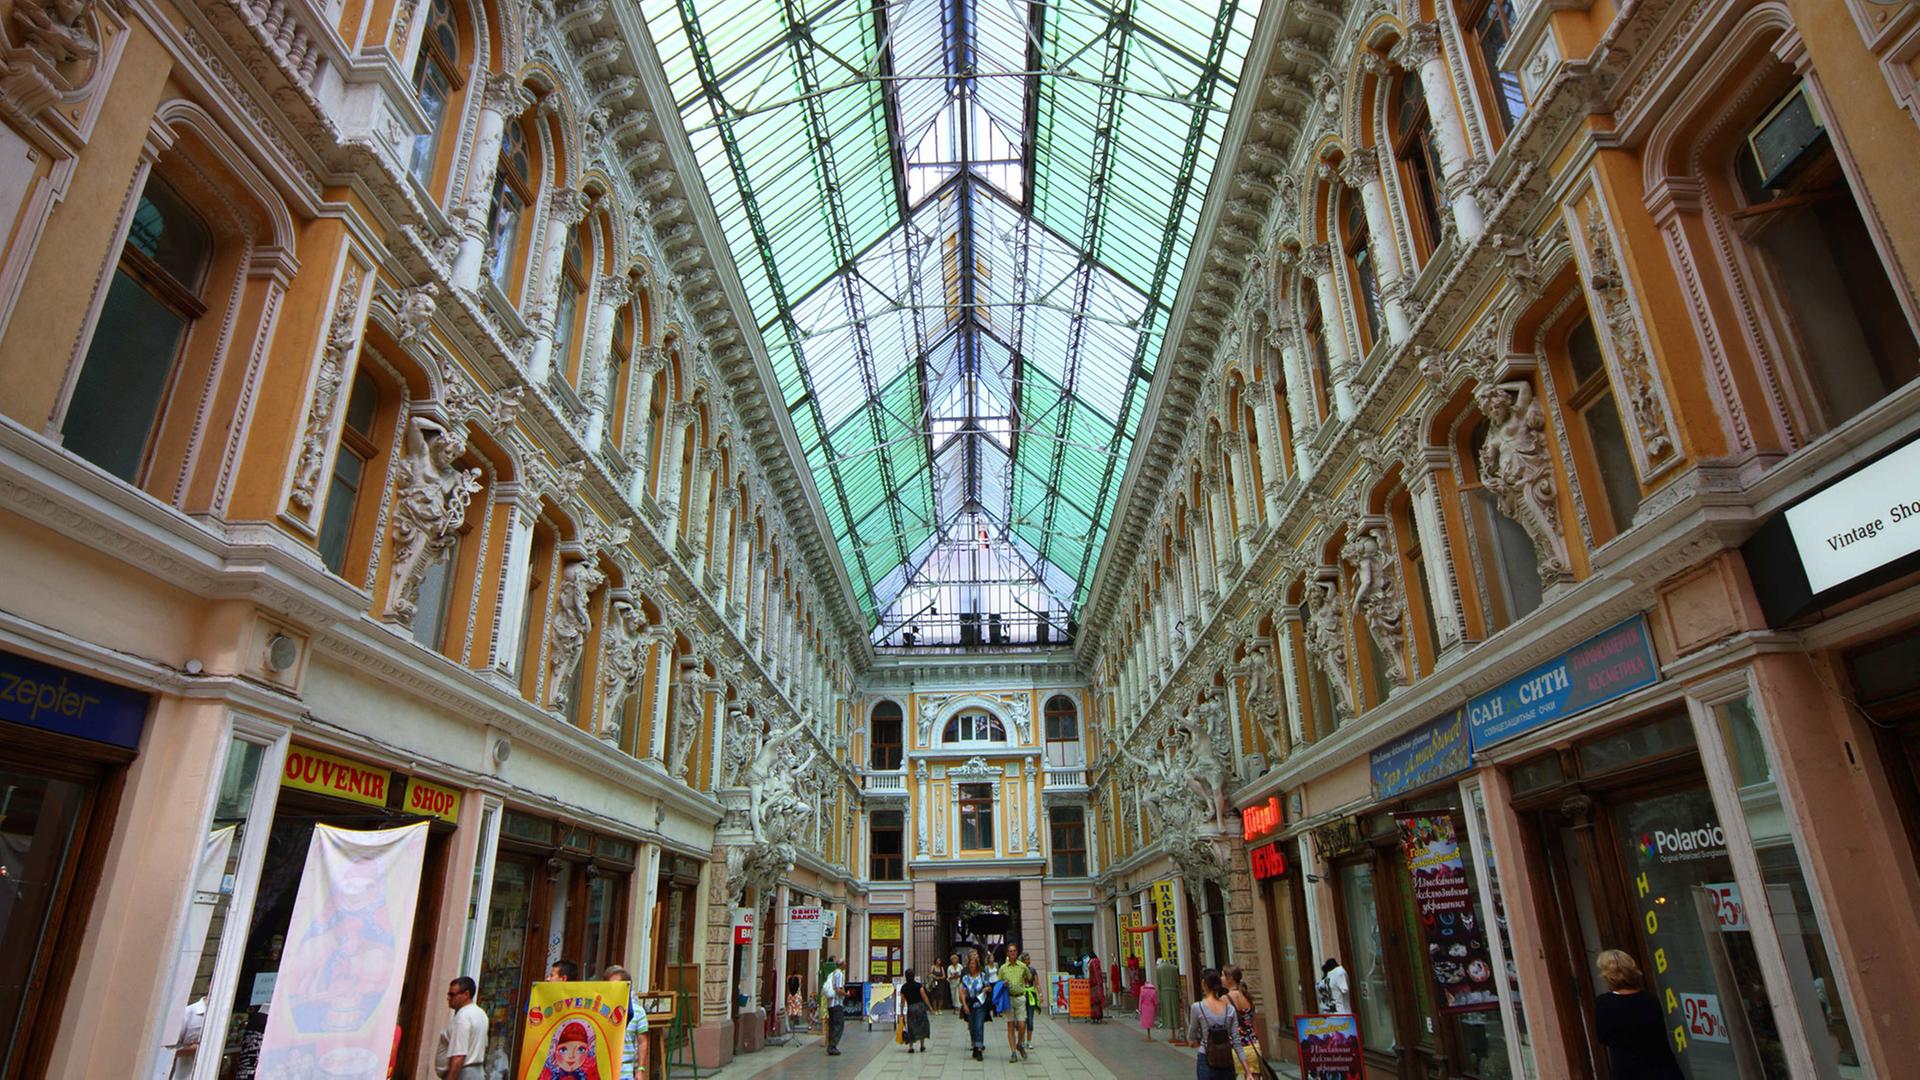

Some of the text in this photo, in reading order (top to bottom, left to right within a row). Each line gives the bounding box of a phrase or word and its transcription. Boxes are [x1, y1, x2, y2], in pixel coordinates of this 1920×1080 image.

[1827, 500, 1920, 551] Vintage Sho
[1, 672, 101, 720] zepter
[1471, 665, 1569, 726] САН СИТИ
[285, 753, 454, 816] OUVENIR SHOP
[1636, 872, 1688, 1053] НОВАЯ
